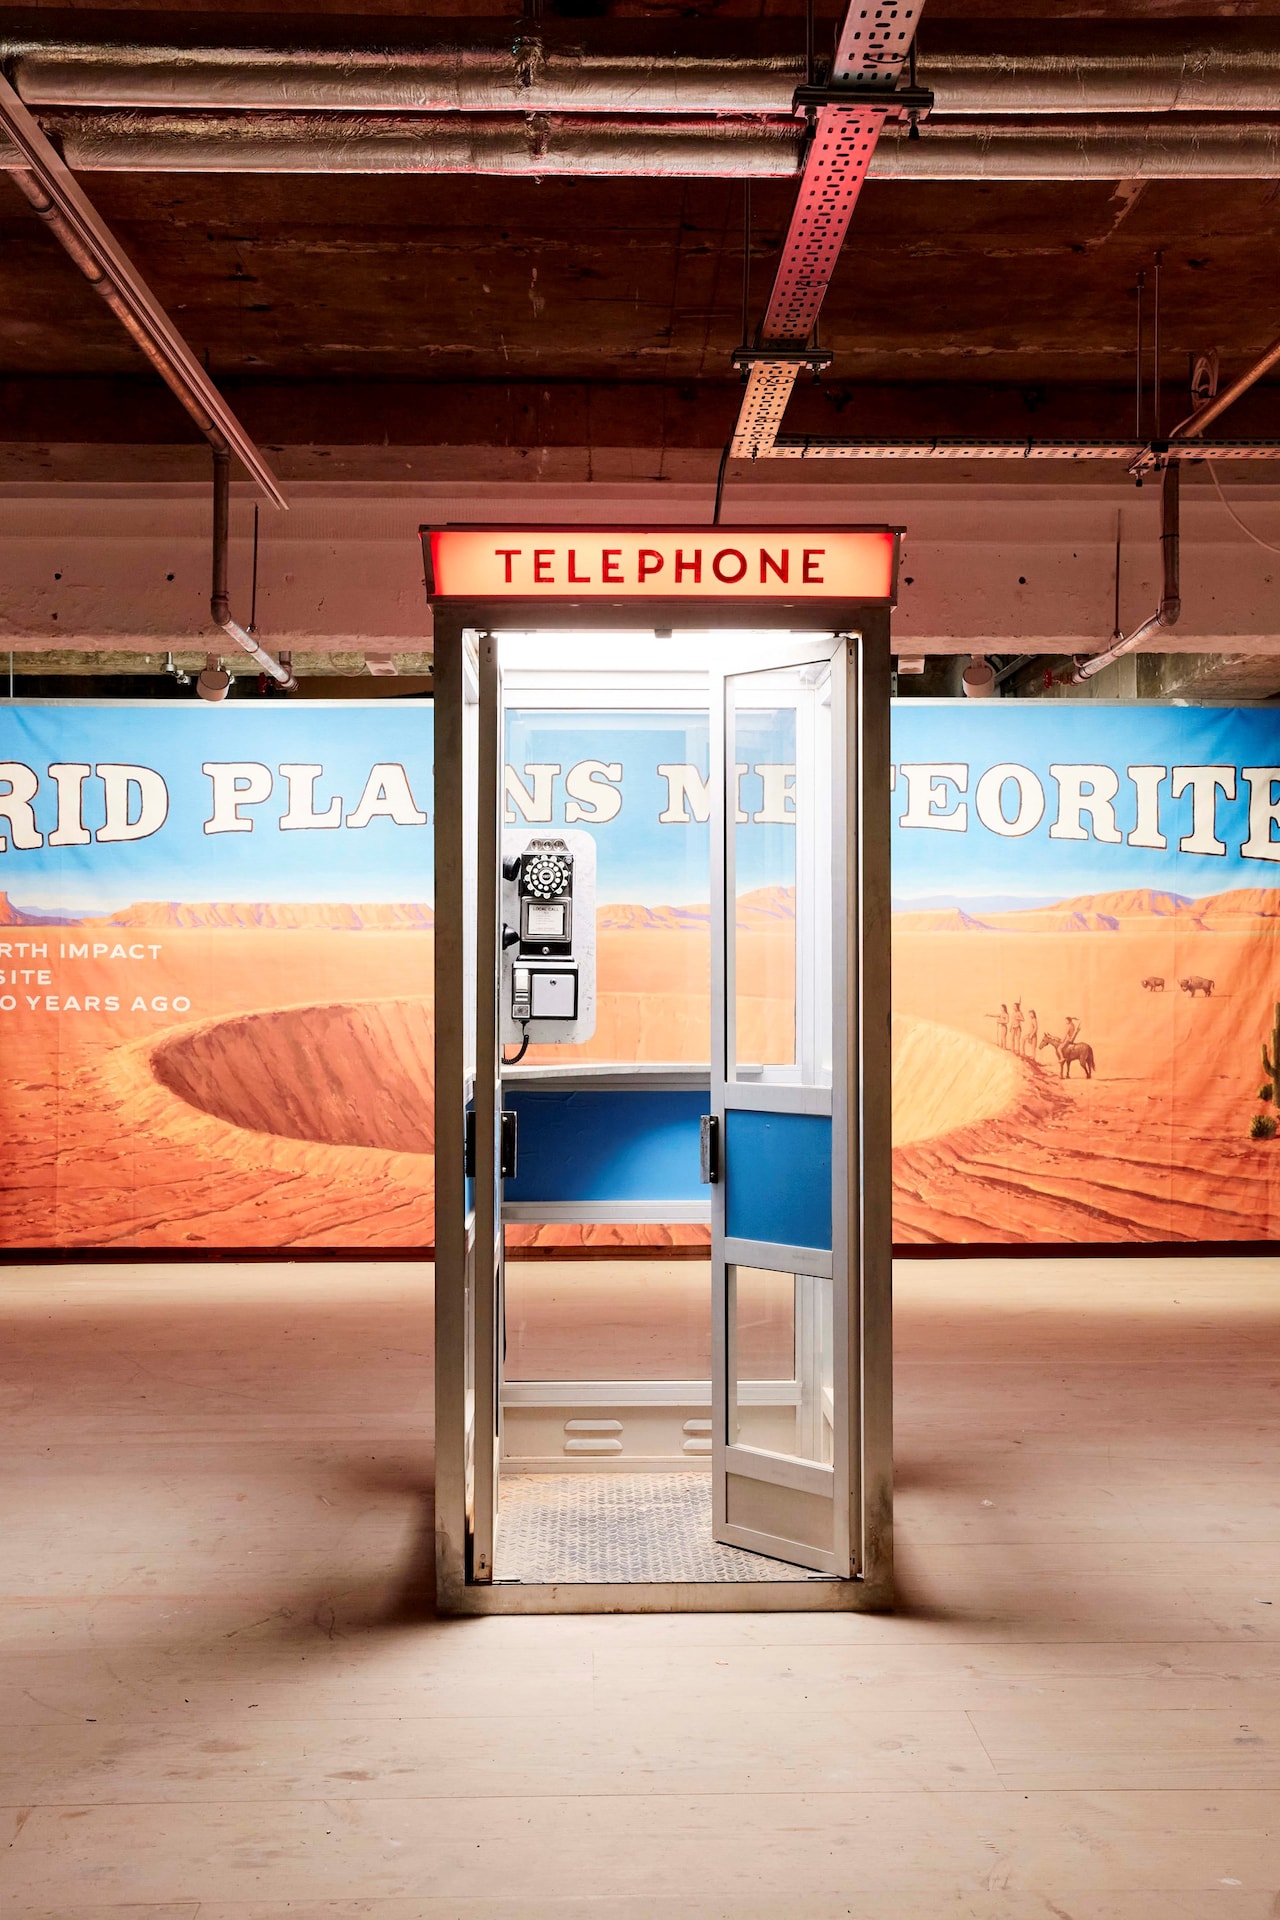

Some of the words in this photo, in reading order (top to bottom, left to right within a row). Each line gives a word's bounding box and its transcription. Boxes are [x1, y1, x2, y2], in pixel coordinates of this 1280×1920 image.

[495, 548, 826, 584] TELEPHONE
[202, 759, 623, 835] PLANS
[0, 943, 48, 959] RTH
[60, 943, 162, 960] IMPACT
[26, 995, 120, 1012] YEARS
[130, 996, 191, 1012] AGO
